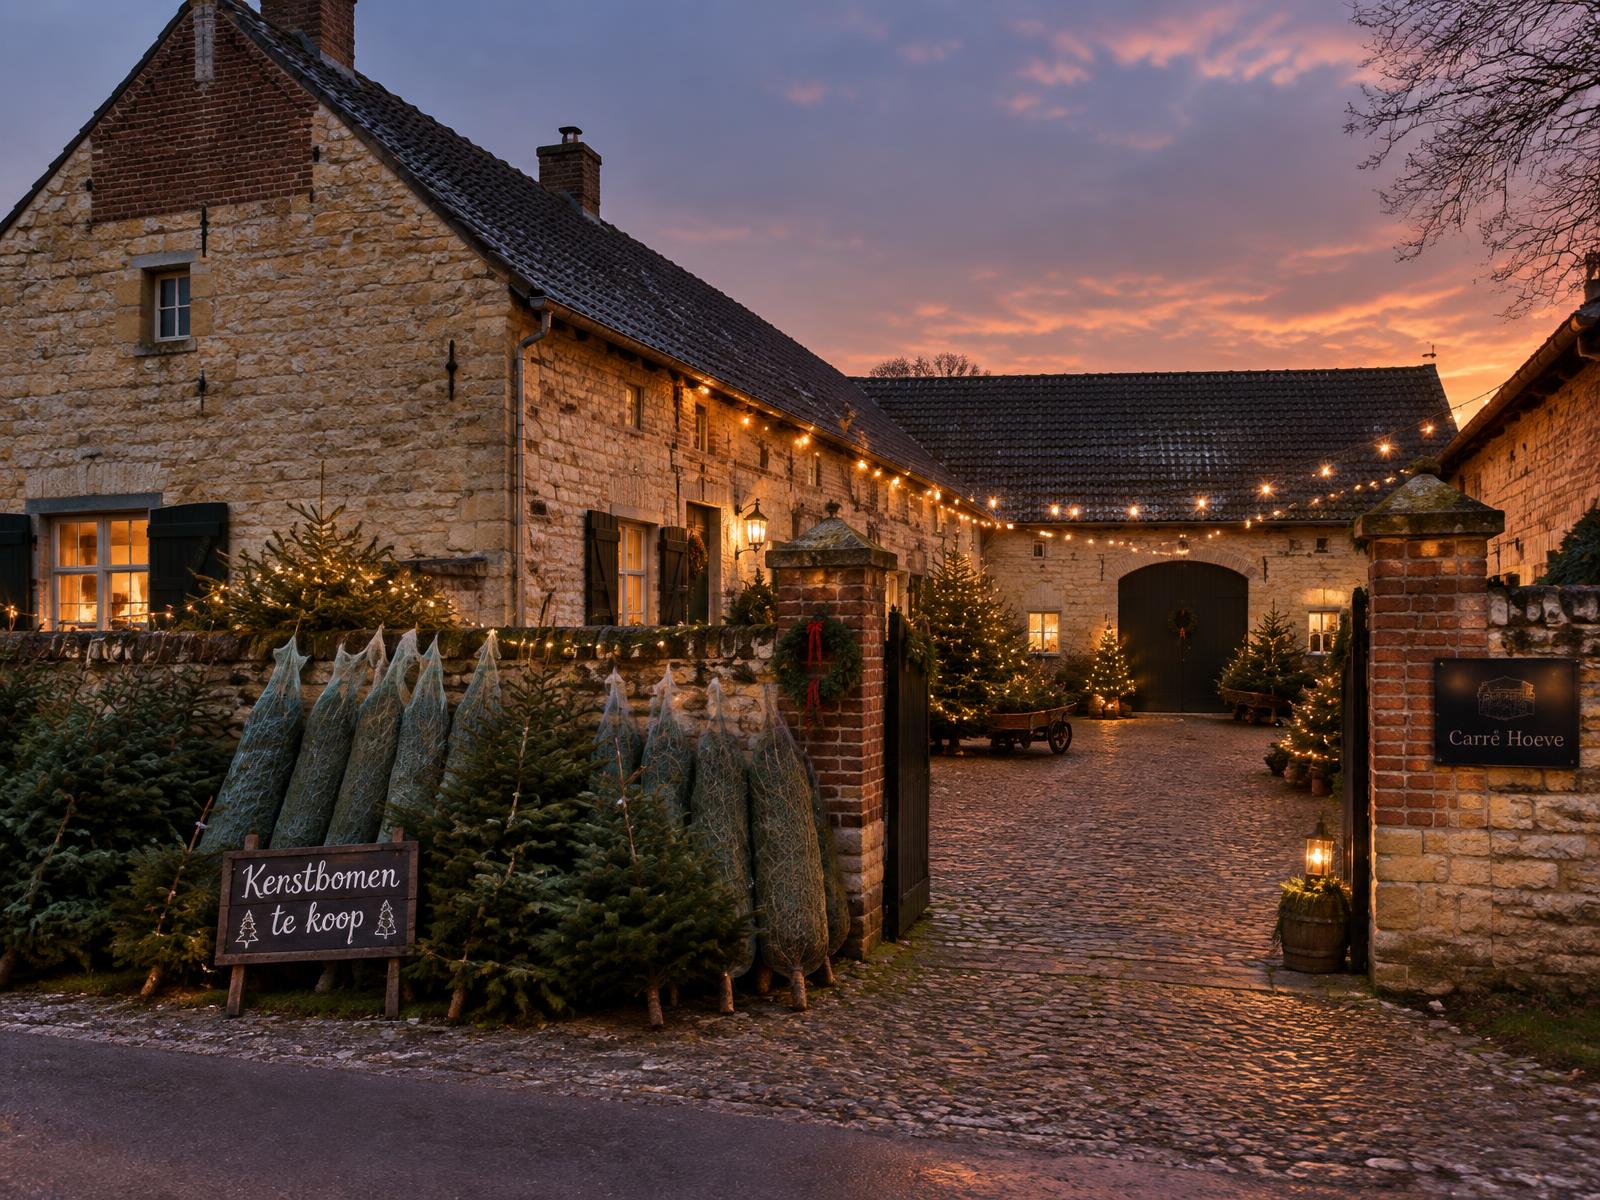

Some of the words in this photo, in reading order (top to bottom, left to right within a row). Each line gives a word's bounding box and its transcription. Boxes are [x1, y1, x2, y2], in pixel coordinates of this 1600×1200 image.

[1507, 730, 1564, 747] Hoeve
[270, 904, 297, 936] te
[305, 901, 364, 945] koop
